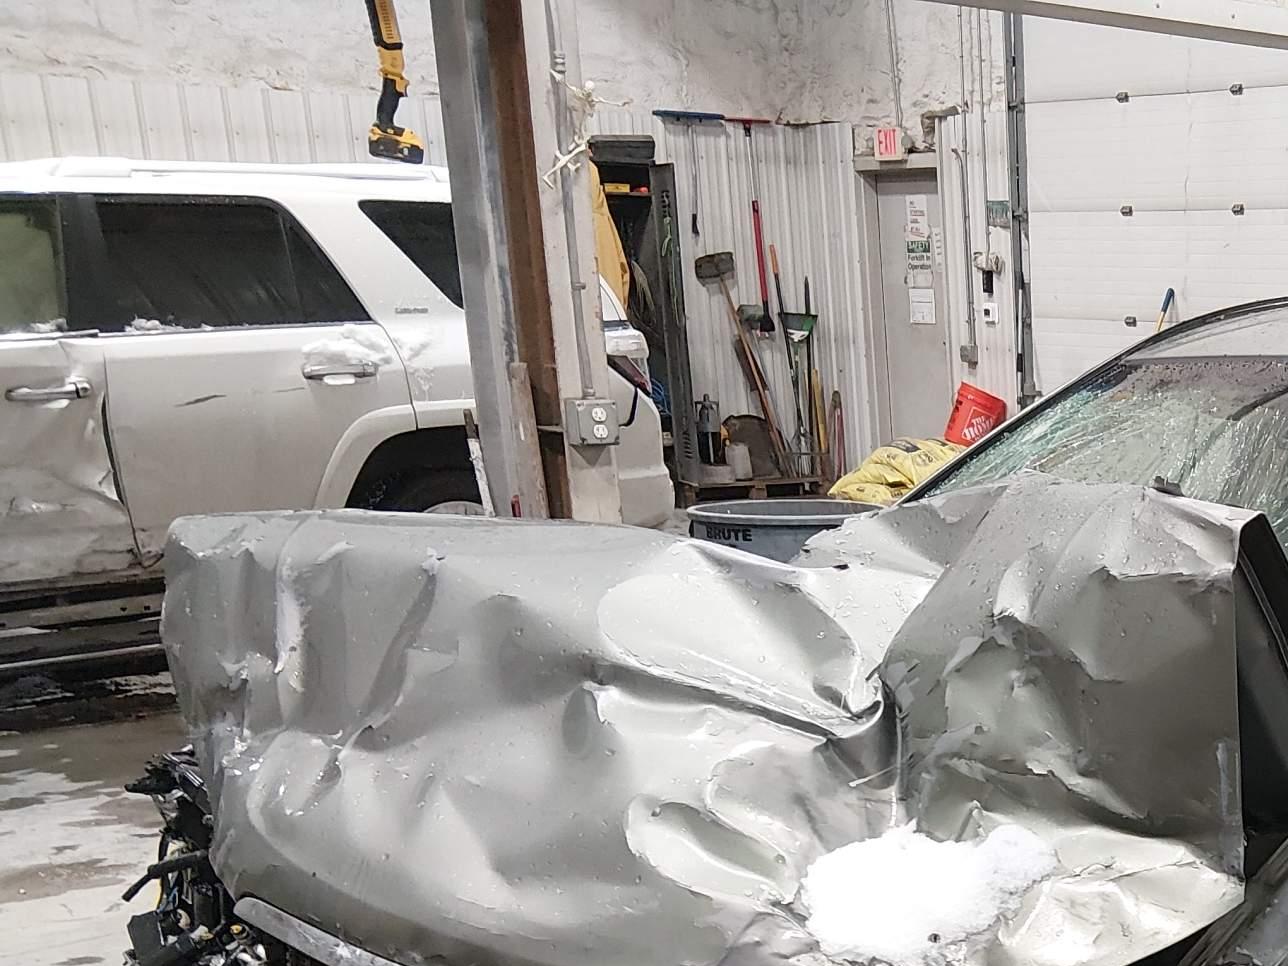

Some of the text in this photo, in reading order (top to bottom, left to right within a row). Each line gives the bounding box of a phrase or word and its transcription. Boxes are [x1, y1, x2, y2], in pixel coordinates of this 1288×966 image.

[878, 129, 897, 155] EXIT
[907, 254, 925, 262] Forklift
[907, 262, 932, 271] Operation
[706, 526, 753, 542] BRUTE
